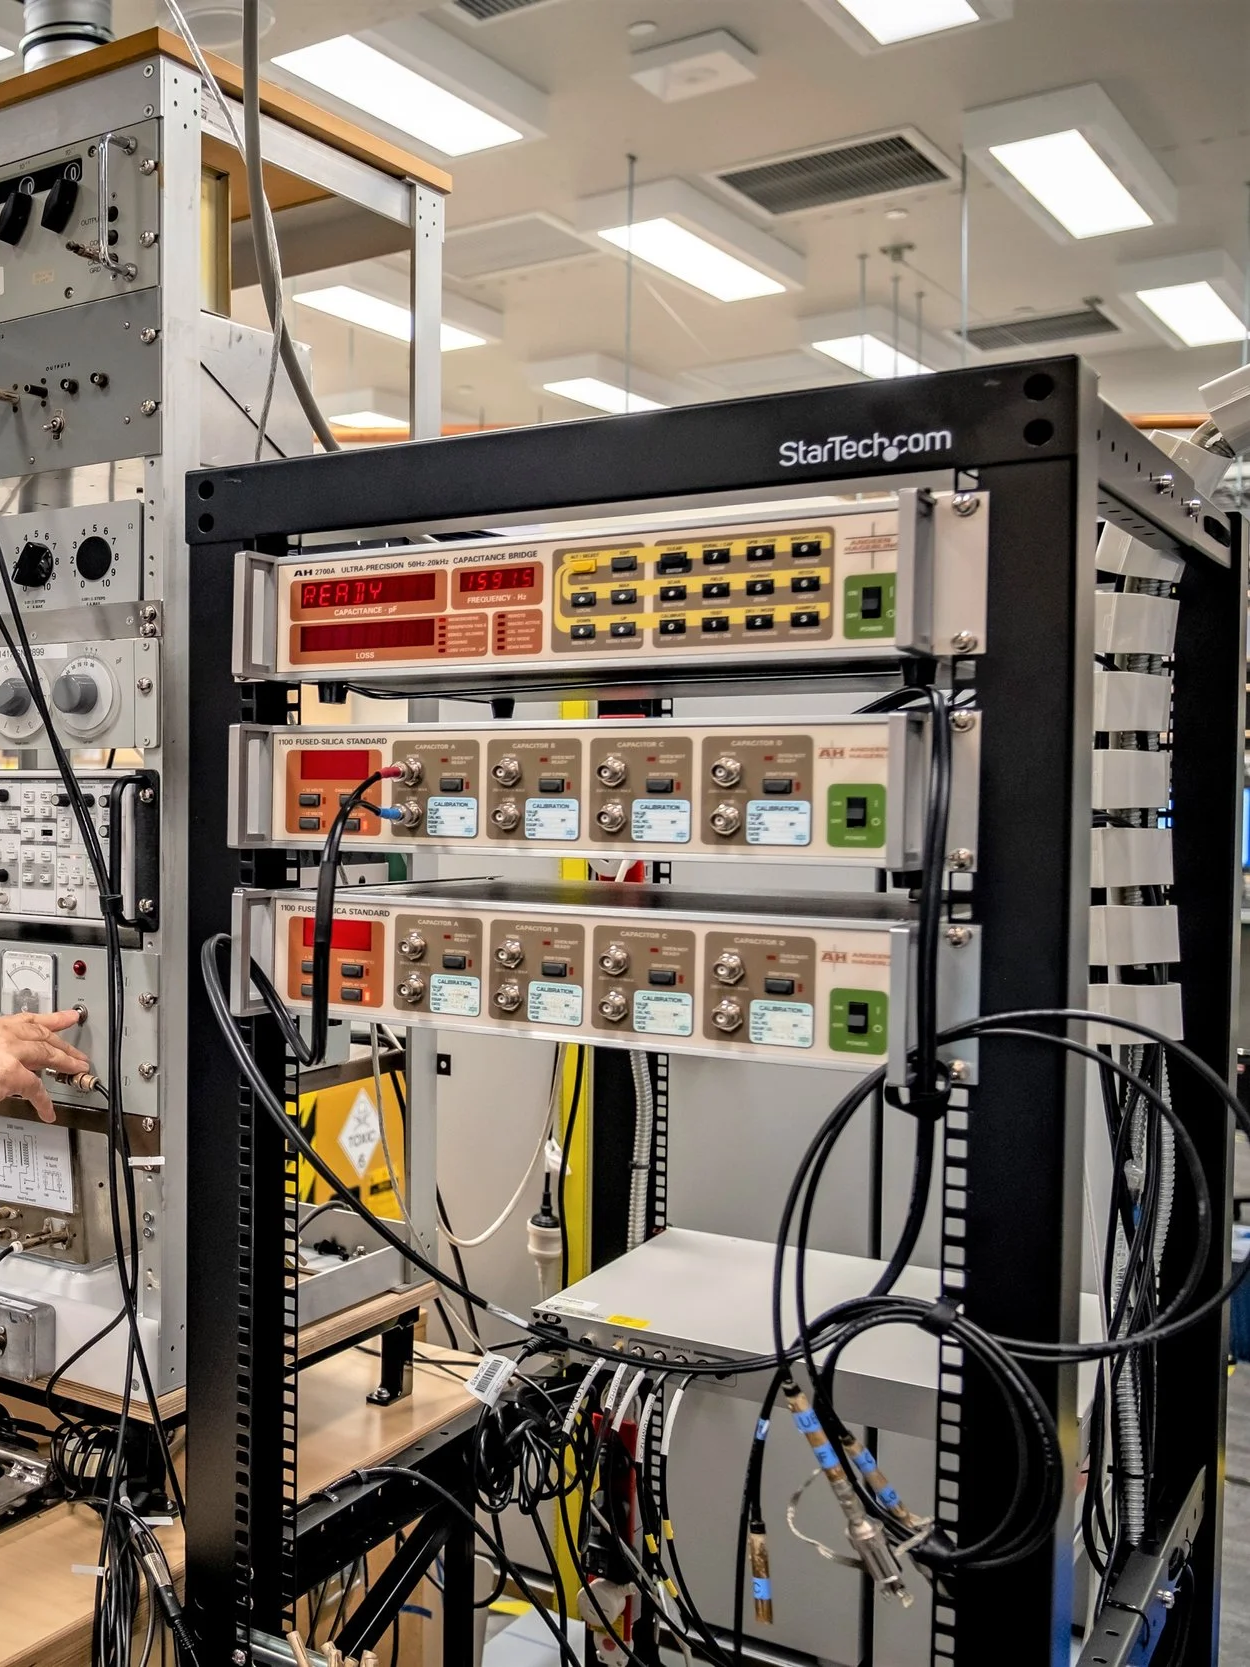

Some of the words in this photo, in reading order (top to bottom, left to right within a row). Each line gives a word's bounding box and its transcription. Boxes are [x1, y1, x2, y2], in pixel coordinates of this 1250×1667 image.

[45, 362, 71, 372] OUTPUTS
[779, 430, 952, 467] StarTech.com
[294, 569, 313, 577] AH
[315, 567, 335, 576] 2700A
[341, 562, 404, 573] ULTRA-PRECISION
[408, 559, 449, 568] 50Hz-20kHz
[453, 553, 506, 564] CAPACITANCE
[508, 550, 538, 560] BRIDGE
[303, 582, 382, 606] READY
[467, 594, 511, 604] FREQUENCY
[334, 606, 383, 616] CAPACITANCE
[388, 605, 398, 614] pF
[355, 651, 375, 660] LOSS
[295, 738, 344, 746] FUSED-SILICA
[819, 749, 844, 758] AH
[349, 908, 390, 917] STANDARD
[515, 924, 551, 932] CAPACITOR
[734, 937, 777, 945] CAPACITOR
[822, 952, 847, 962] AH
[536, 986, 573, 994] CALIBRATION
[759, 1005, 803, 1013] CALIBRATION
